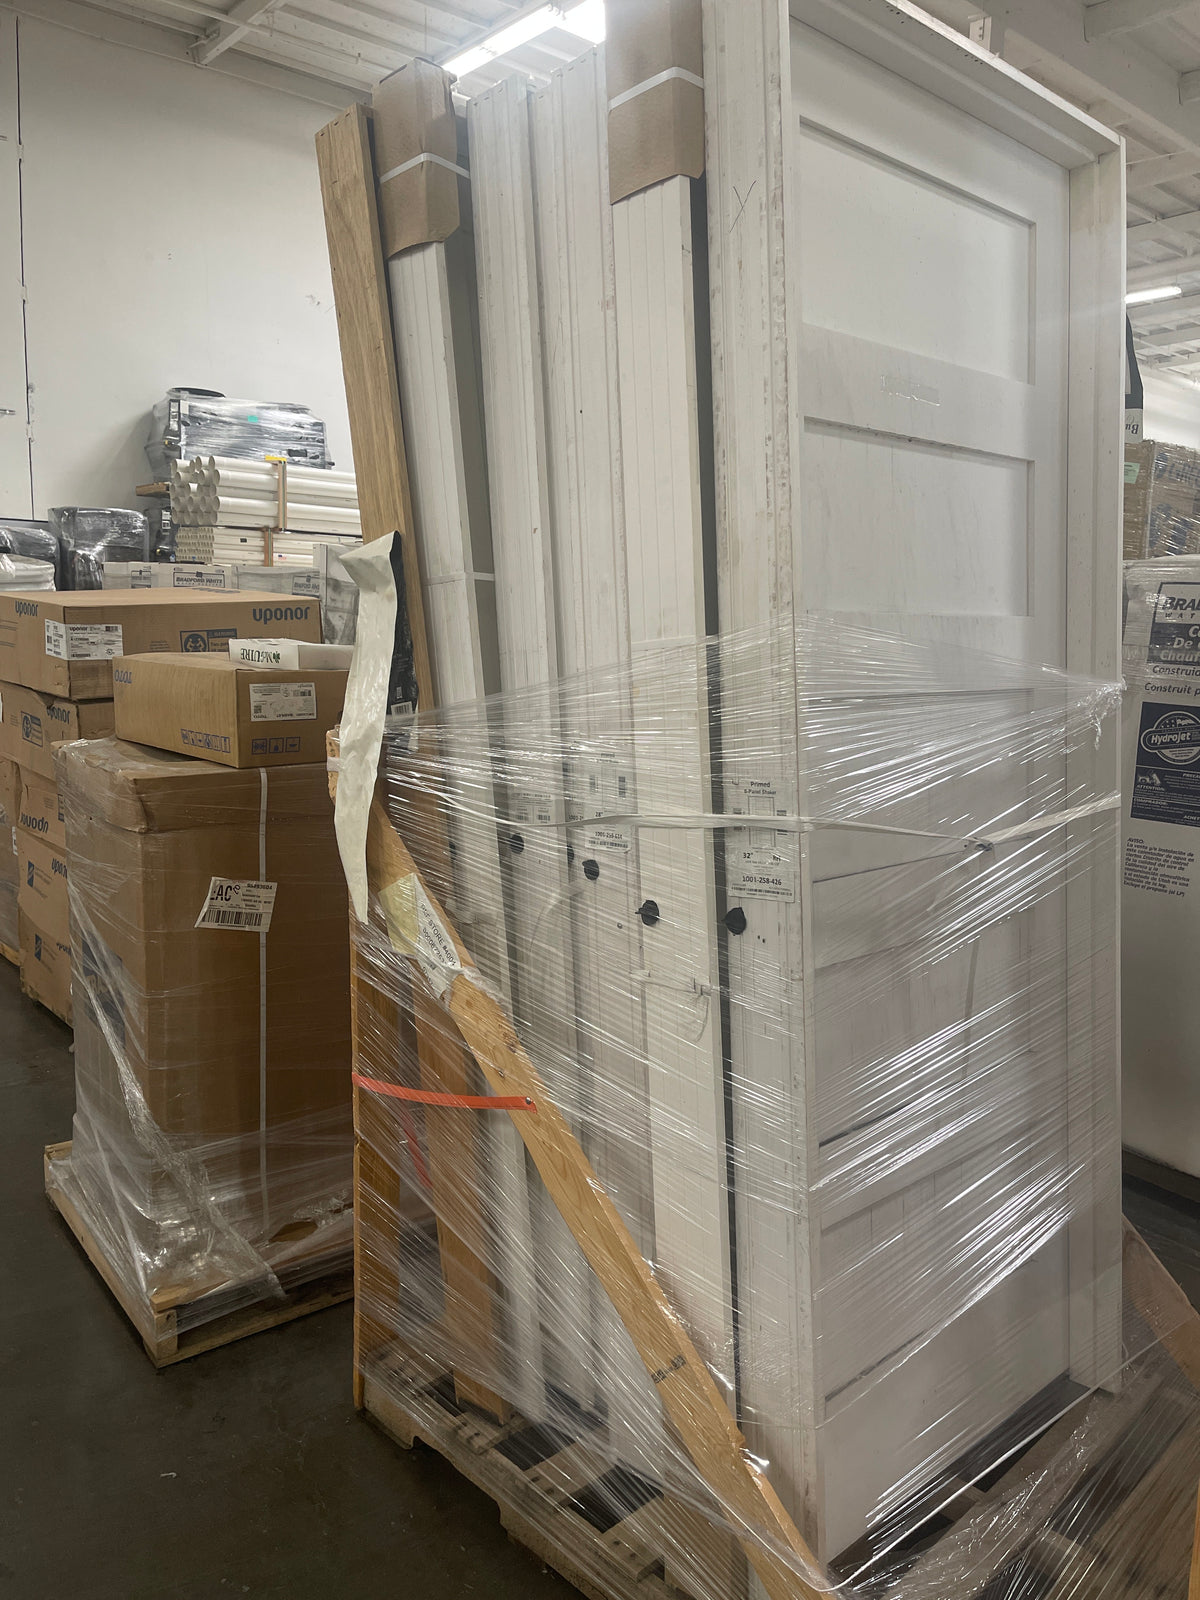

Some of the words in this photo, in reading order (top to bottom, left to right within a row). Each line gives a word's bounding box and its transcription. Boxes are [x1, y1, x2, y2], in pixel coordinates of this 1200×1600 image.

[15, 600, 38, 617] uponor
[252, 606, 310, 625] uponor
[114, 670, 133, 685] TOTO
[1144, 682, 1191, 694] Construit
[428, 919, 444, 946] STORE
